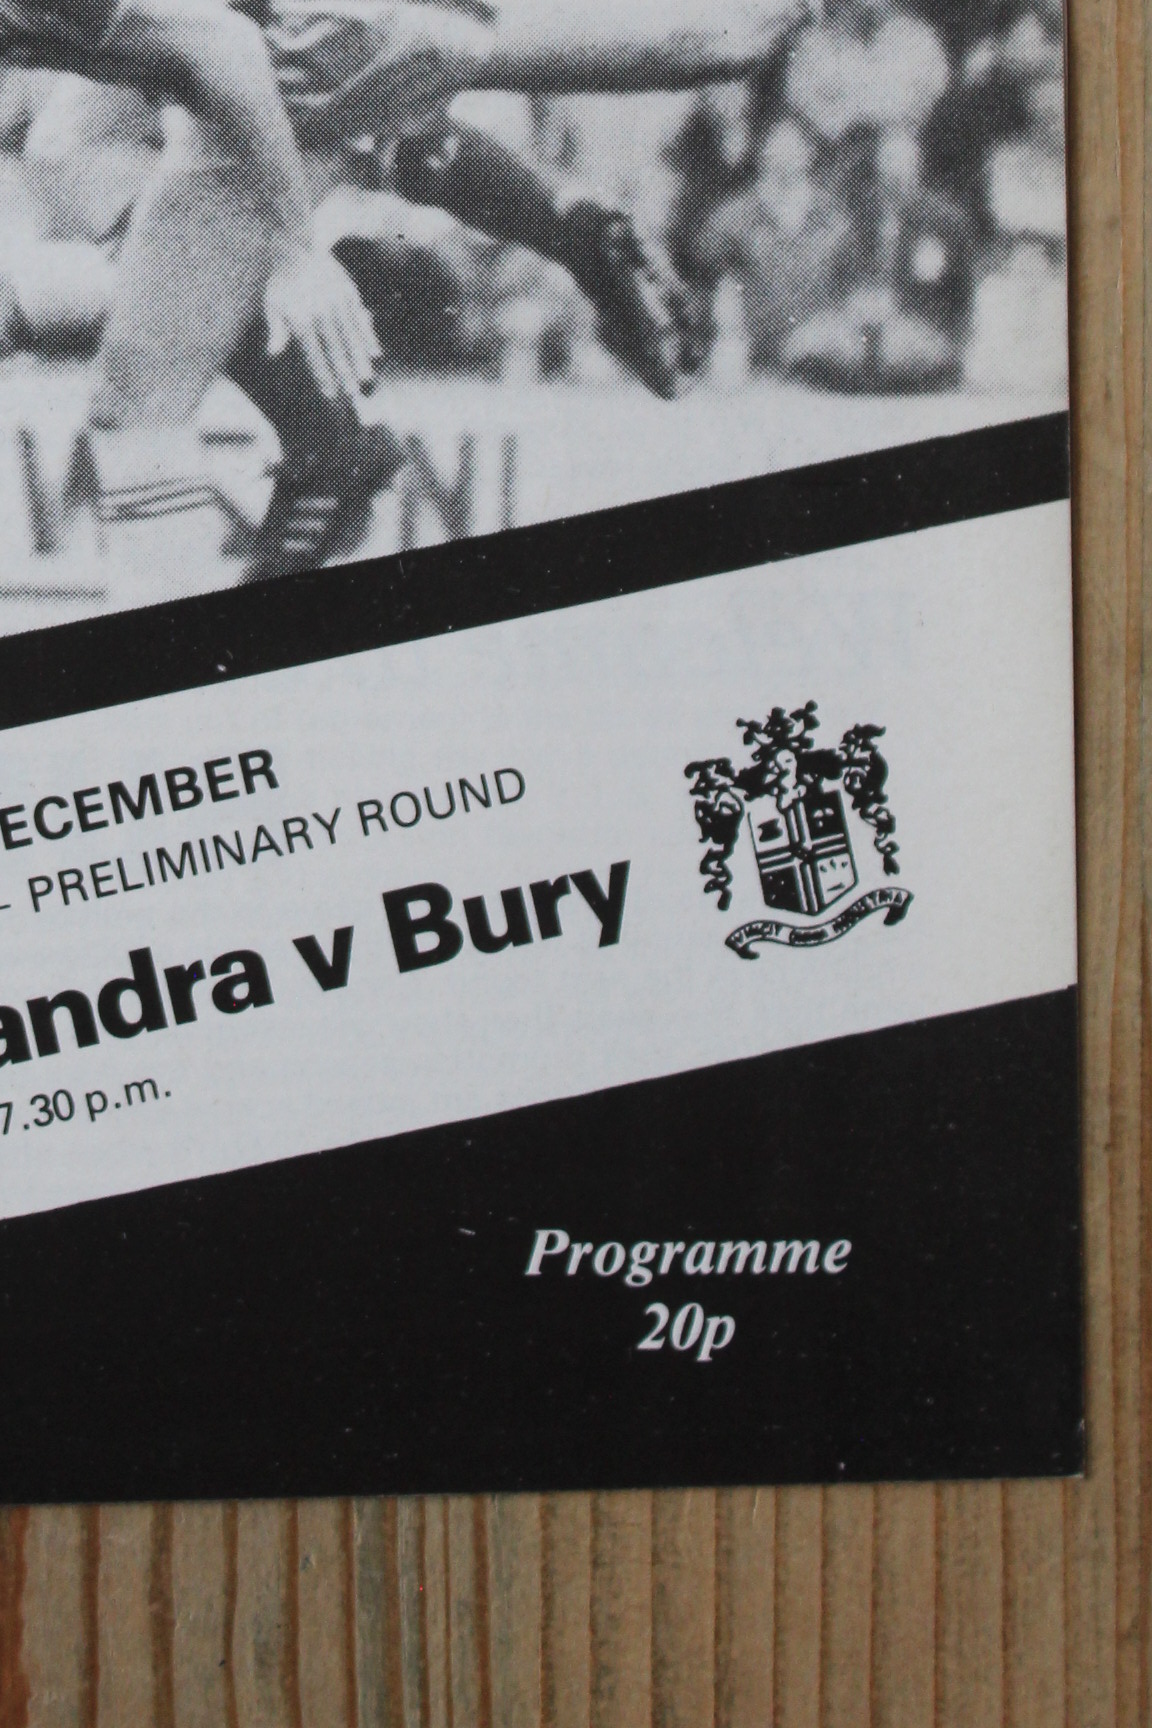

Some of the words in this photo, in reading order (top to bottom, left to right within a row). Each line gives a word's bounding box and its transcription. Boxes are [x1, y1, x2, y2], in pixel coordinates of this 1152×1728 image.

[27, 808, 341, 913] PRELIMINARY
[357, 768, 526, 837] ROUND
[292, 925, 354, 992] v
[382, 860, 630, 973] Bury
[85, 1079, 172, 1122] p.m.
[525, 1229, 852, 1287] Programme
[637, 1302, 736, 1362] 20p
